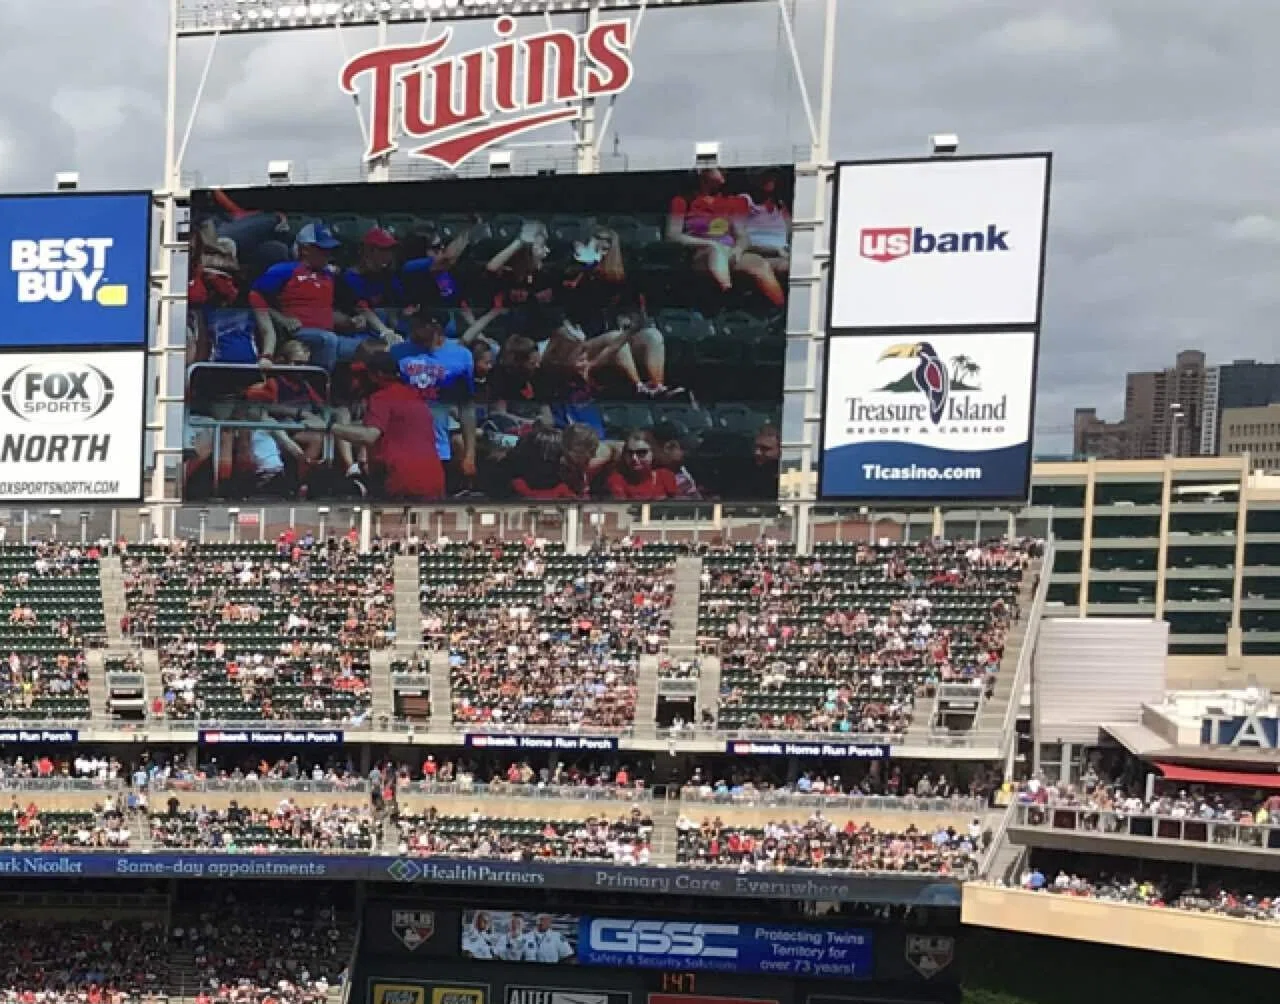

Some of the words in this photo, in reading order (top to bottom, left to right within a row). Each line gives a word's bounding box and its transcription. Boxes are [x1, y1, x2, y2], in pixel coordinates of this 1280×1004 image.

[339, 15, 635, 162] Twins
[11, 237, 115, 270] BEST
[17, 270, 105, 303] BUY
[24, 371, 90, 401] FOX
[24, 401, 92, 413] SPORTS
[845, 396, 927, 422] Treasure
[947, 393, 1007, 421] Island
[0, 433, 111, 463] NORTH
[20, 731, 40, 741] Run
[42, 731, 72, 742] Porch
[252, 731, 282, 743] Home
[285, 731, 305, 743] Run
[307, 731, 338, 743] Porch
[521, 737, 552, 748] Home
[555, 738, 577, 749] Run
[579, 739, 612, 750] Porch
[1201, 714, 1280, 749] TA
[785, 744, 819, 756] Home
[822, 745, 845, 757] Run
[847, 746, 883, 758] Porch
[23, 857, 83, 873] Nicollet
[116, 858, 204, 876] Same-day
[208, 859, 325, 877] appointments
[423, 863, 545, 884] HealthPartners
[595, 871, 671, 892] Primary
[676, 875, 721, 891] Care
[590, 918, 739, 958] GSSC
[755, 927, 823, 945] Protecting
[827, 931, 864, 945] Twins
[771, 943, 825, 960] Territory
[828, 946, 848, 959] for
[760, 960, 791, 971] over
[794, 960, 811, 972] 73
[813, 961, 856, 976] years!
